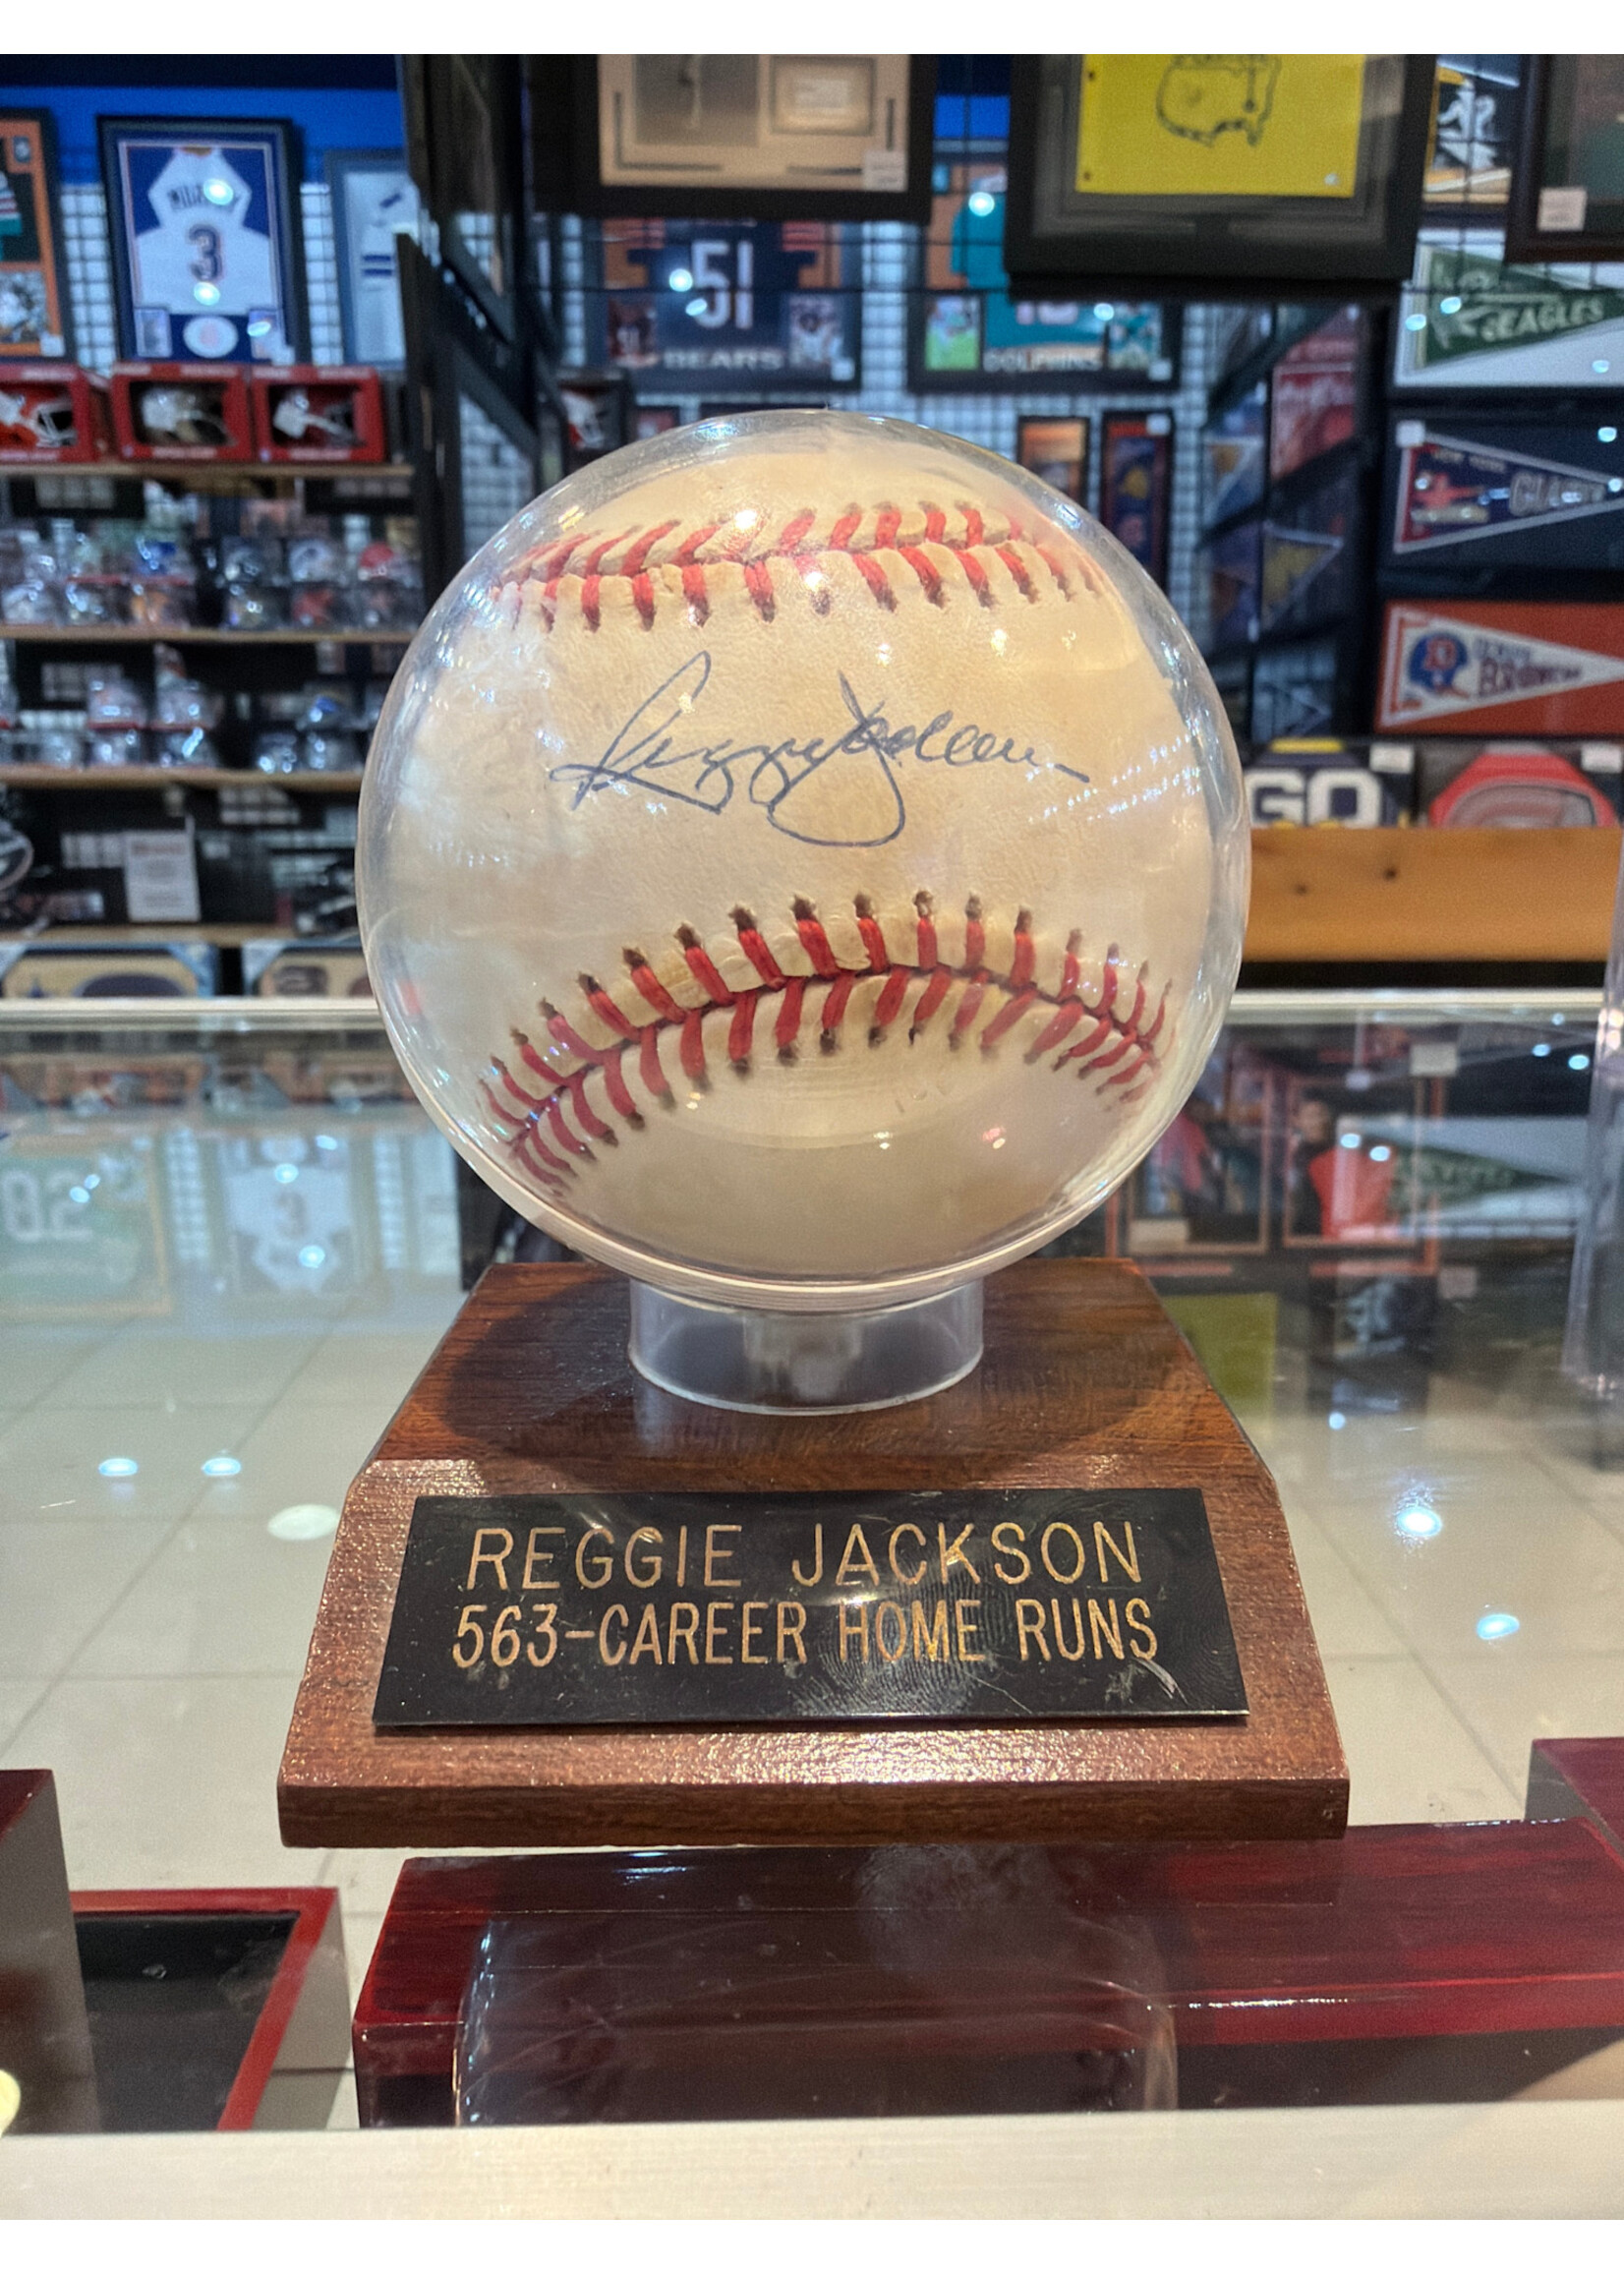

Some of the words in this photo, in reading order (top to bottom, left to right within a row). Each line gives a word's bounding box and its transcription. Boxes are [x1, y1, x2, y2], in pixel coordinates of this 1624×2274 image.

[187, 224, 224, 283] 3
[691, 239, 753, 330] 51
[1492, 298, 1605, 341] EAGLES
[466, 1524, 743, 1591] REGGIE
[791, 1520, 1142, 1588] JACKSON
[452, 1602, 808, 1668] 563-CAREER
[840, 1599, 985, 1664] HOME
[1015, 1598, 1159, 1662] RUNS
